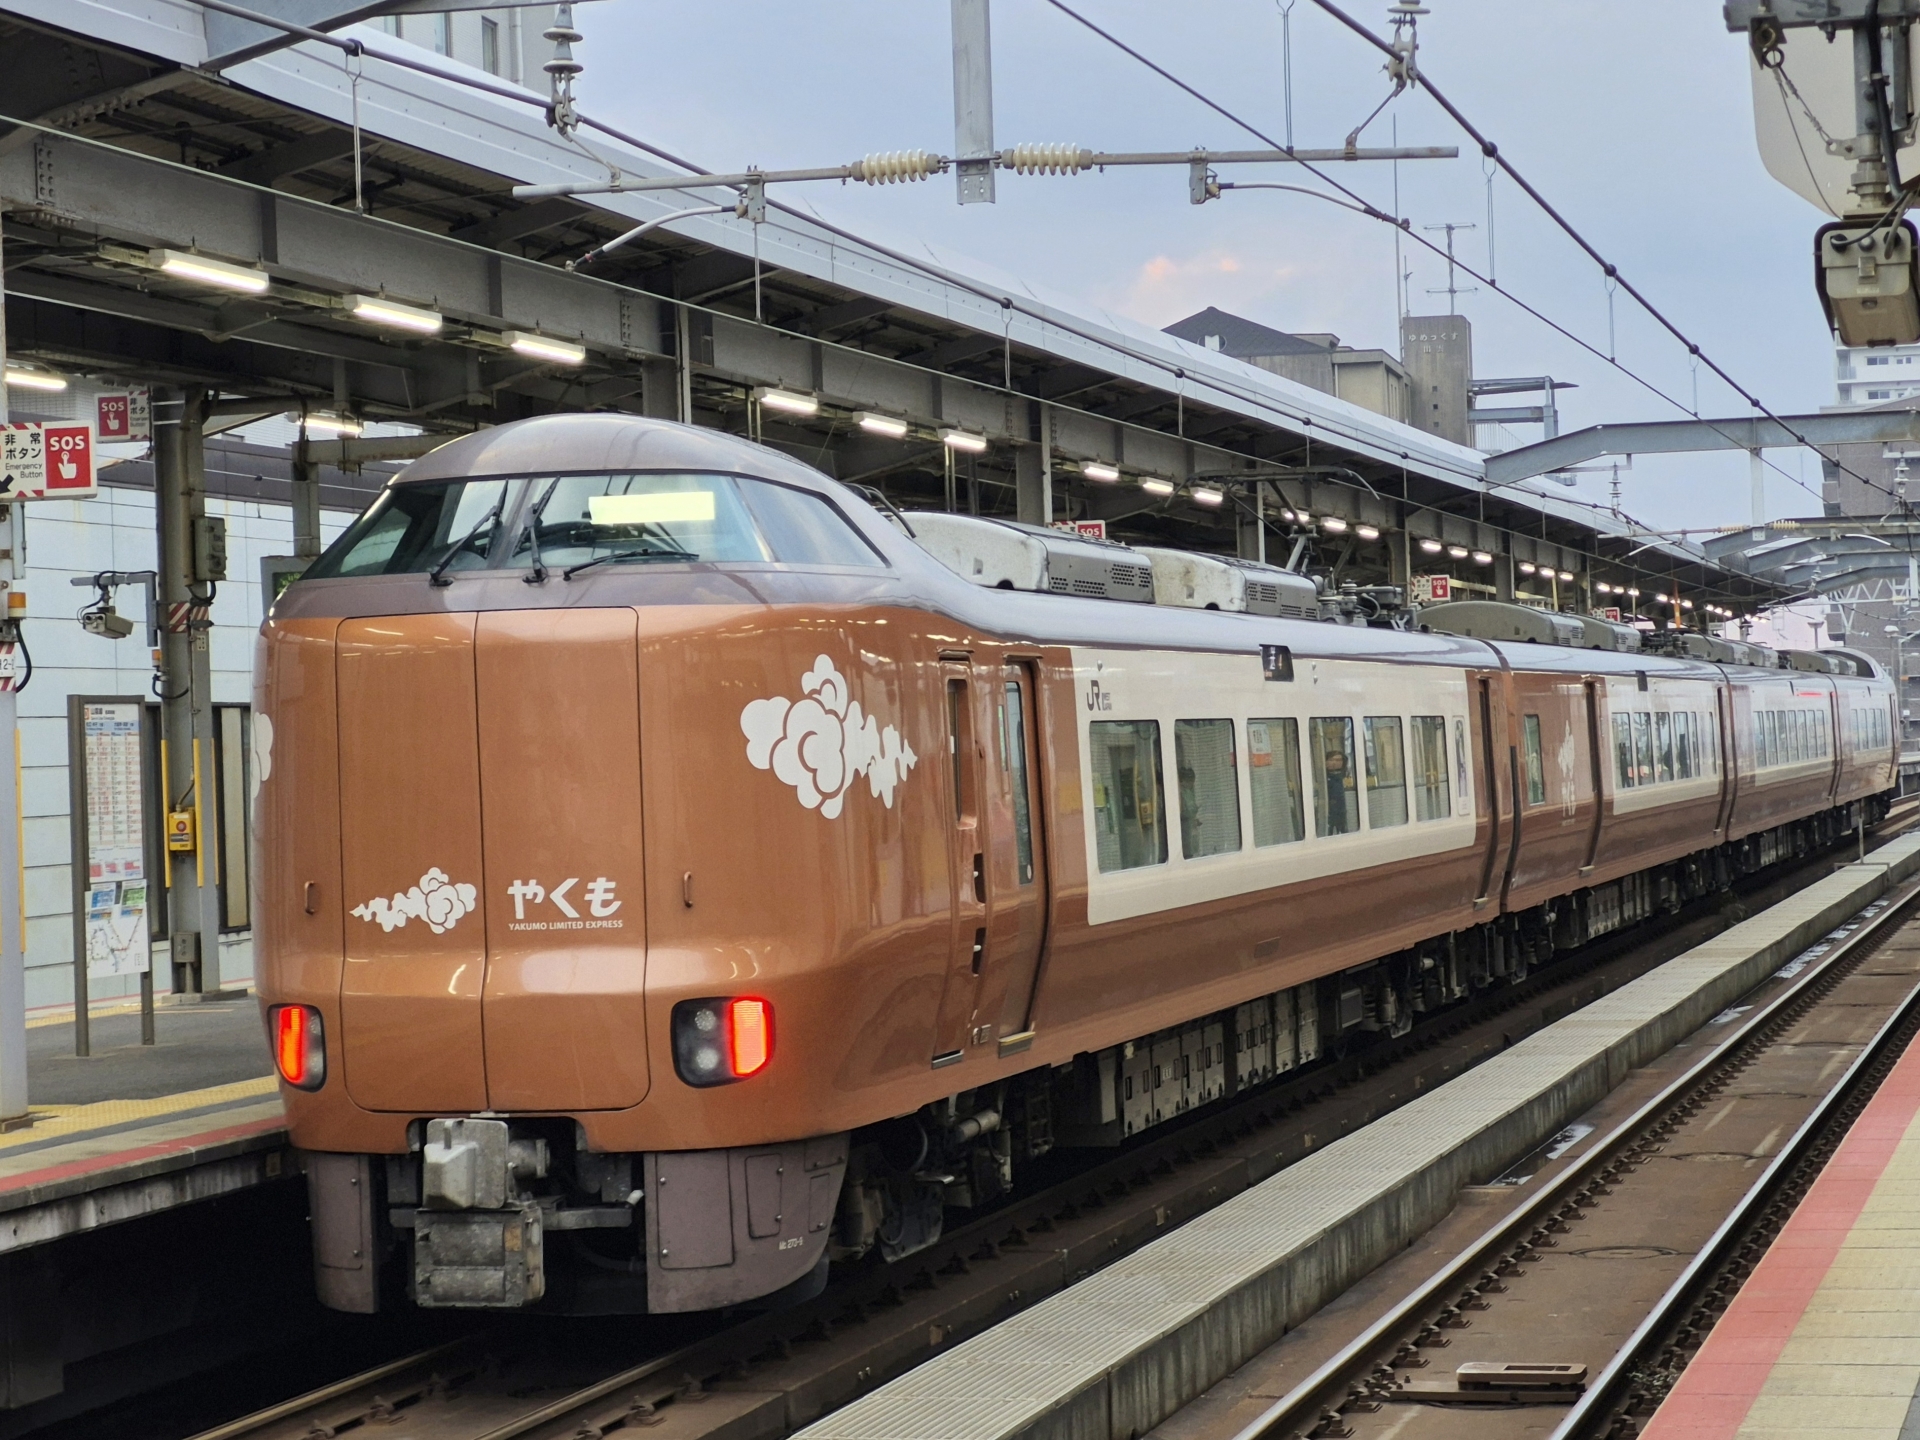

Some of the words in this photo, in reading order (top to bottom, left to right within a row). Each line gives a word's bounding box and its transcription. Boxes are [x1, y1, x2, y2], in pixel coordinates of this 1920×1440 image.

[101, 401, 125, 412] SOS
[130, 406, 149, 415] ボタ
[4, 432, 41, 446] 非常
[49, 435, 86, 451] SOS
[5, 447, 42, 460] ボタン
[5, 462, 43, 471] Emergency
[20, 470, 43, 479] Button
[1080, 527, 1100, 537] SOS
[1086, 679, 1101, 711] JR
[507, 877, 622, 919] やくも
[508, 922, 547, 931] YAKUMO
[549, 921, 584, 930] LIMITED
[585, 919, 623, 929] EXPRESS
